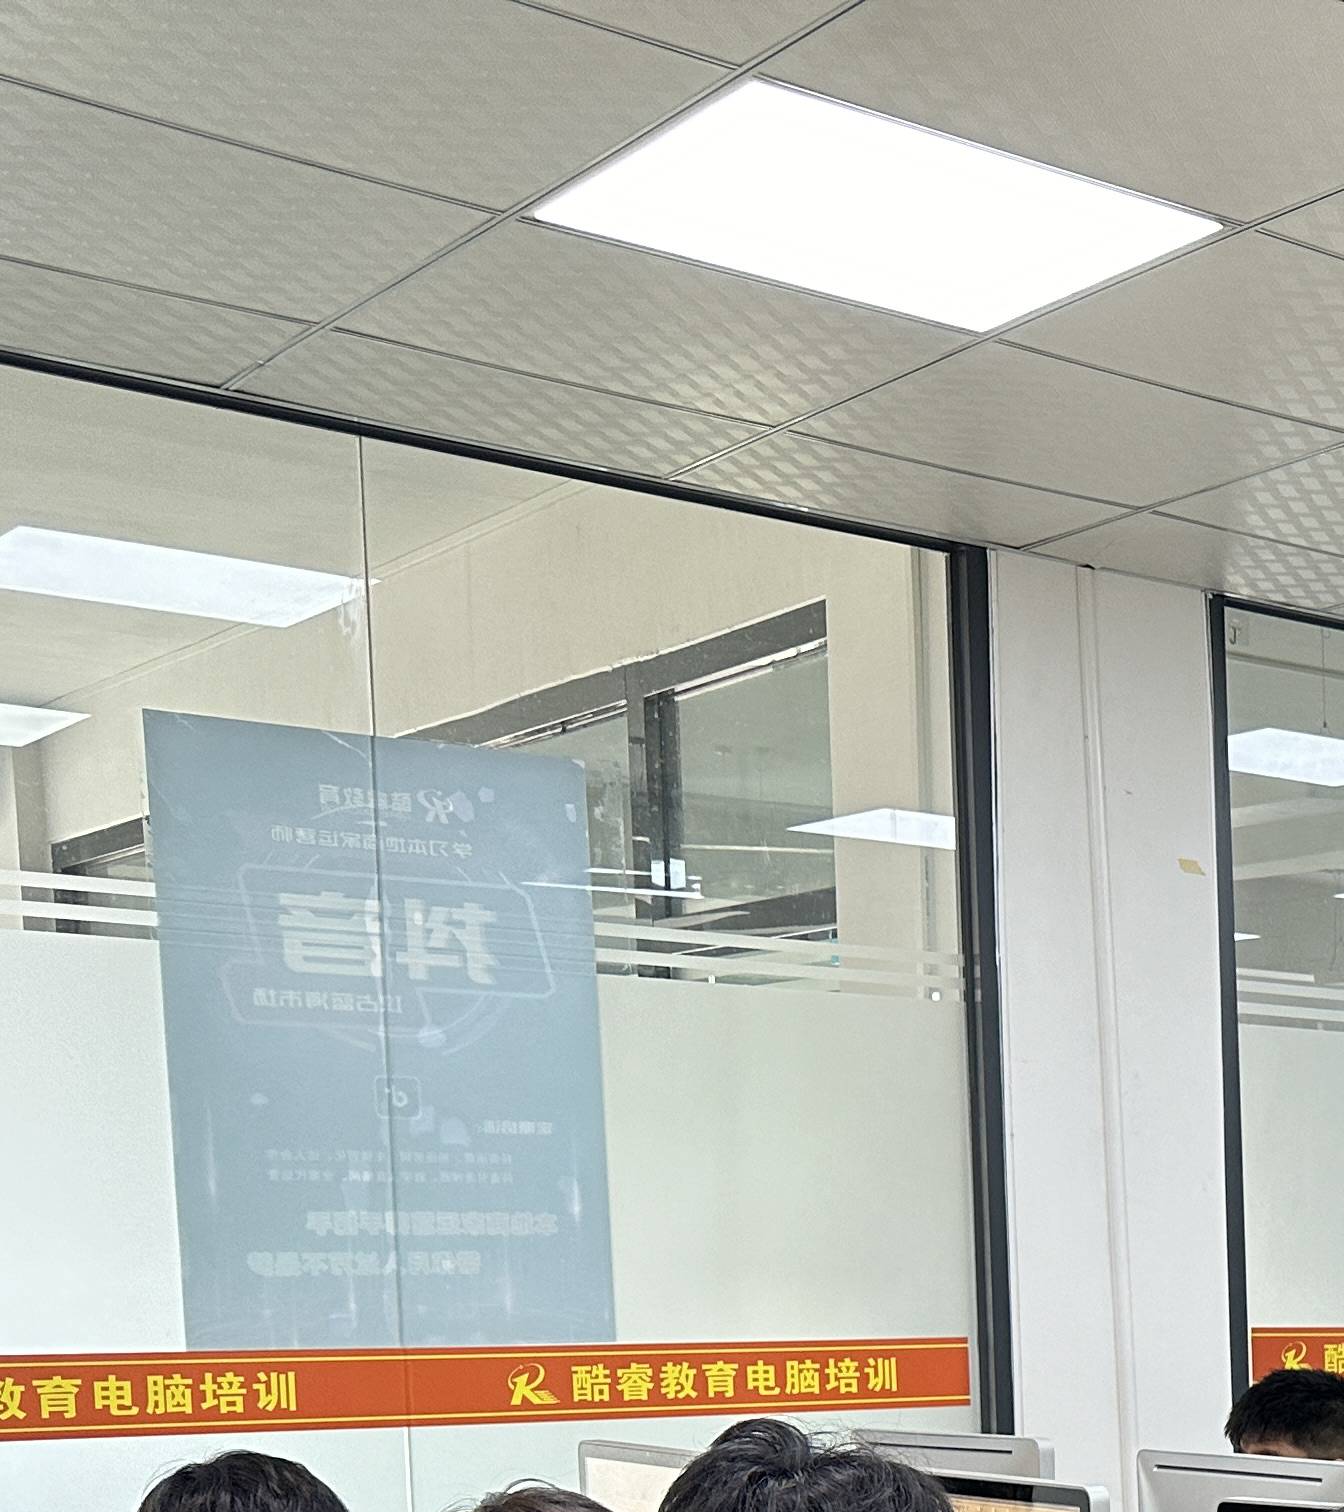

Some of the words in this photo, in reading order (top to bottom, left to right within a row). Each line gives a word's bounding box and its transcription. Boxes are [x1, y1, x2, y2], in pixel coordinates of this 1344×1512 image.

[570, 1357, 899, 1402] 酷睿教育电脑培训
